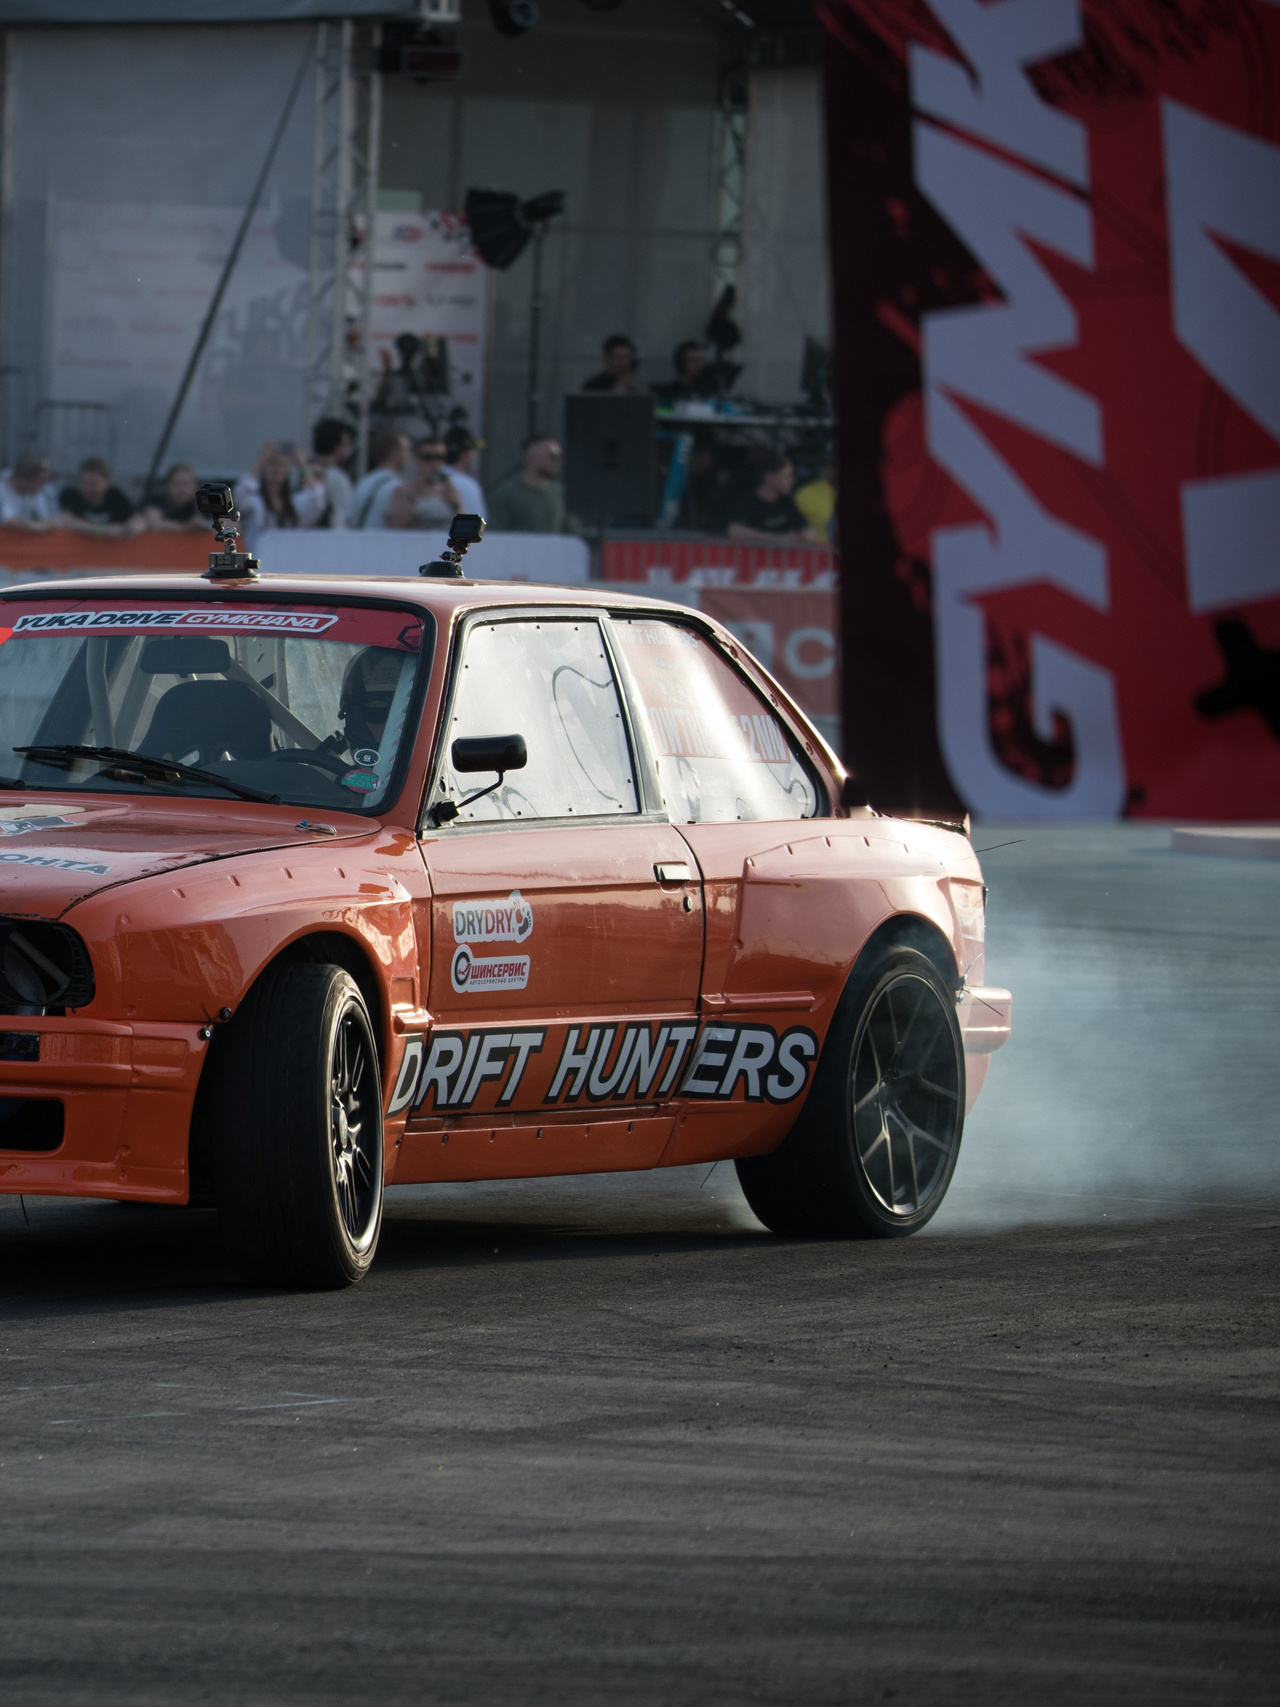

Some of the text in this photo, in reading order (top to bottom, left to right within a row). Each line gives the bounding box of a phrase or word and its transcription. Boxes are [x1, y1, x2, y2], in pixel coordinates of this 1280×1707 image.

[17, 612, 320, 630] YUKA DRIVE GYMKHANA
[470, 962, 527, 979] ШИНСЕРВИС
[387, 1025, 816, 1114] DRIFT HUNTERS
